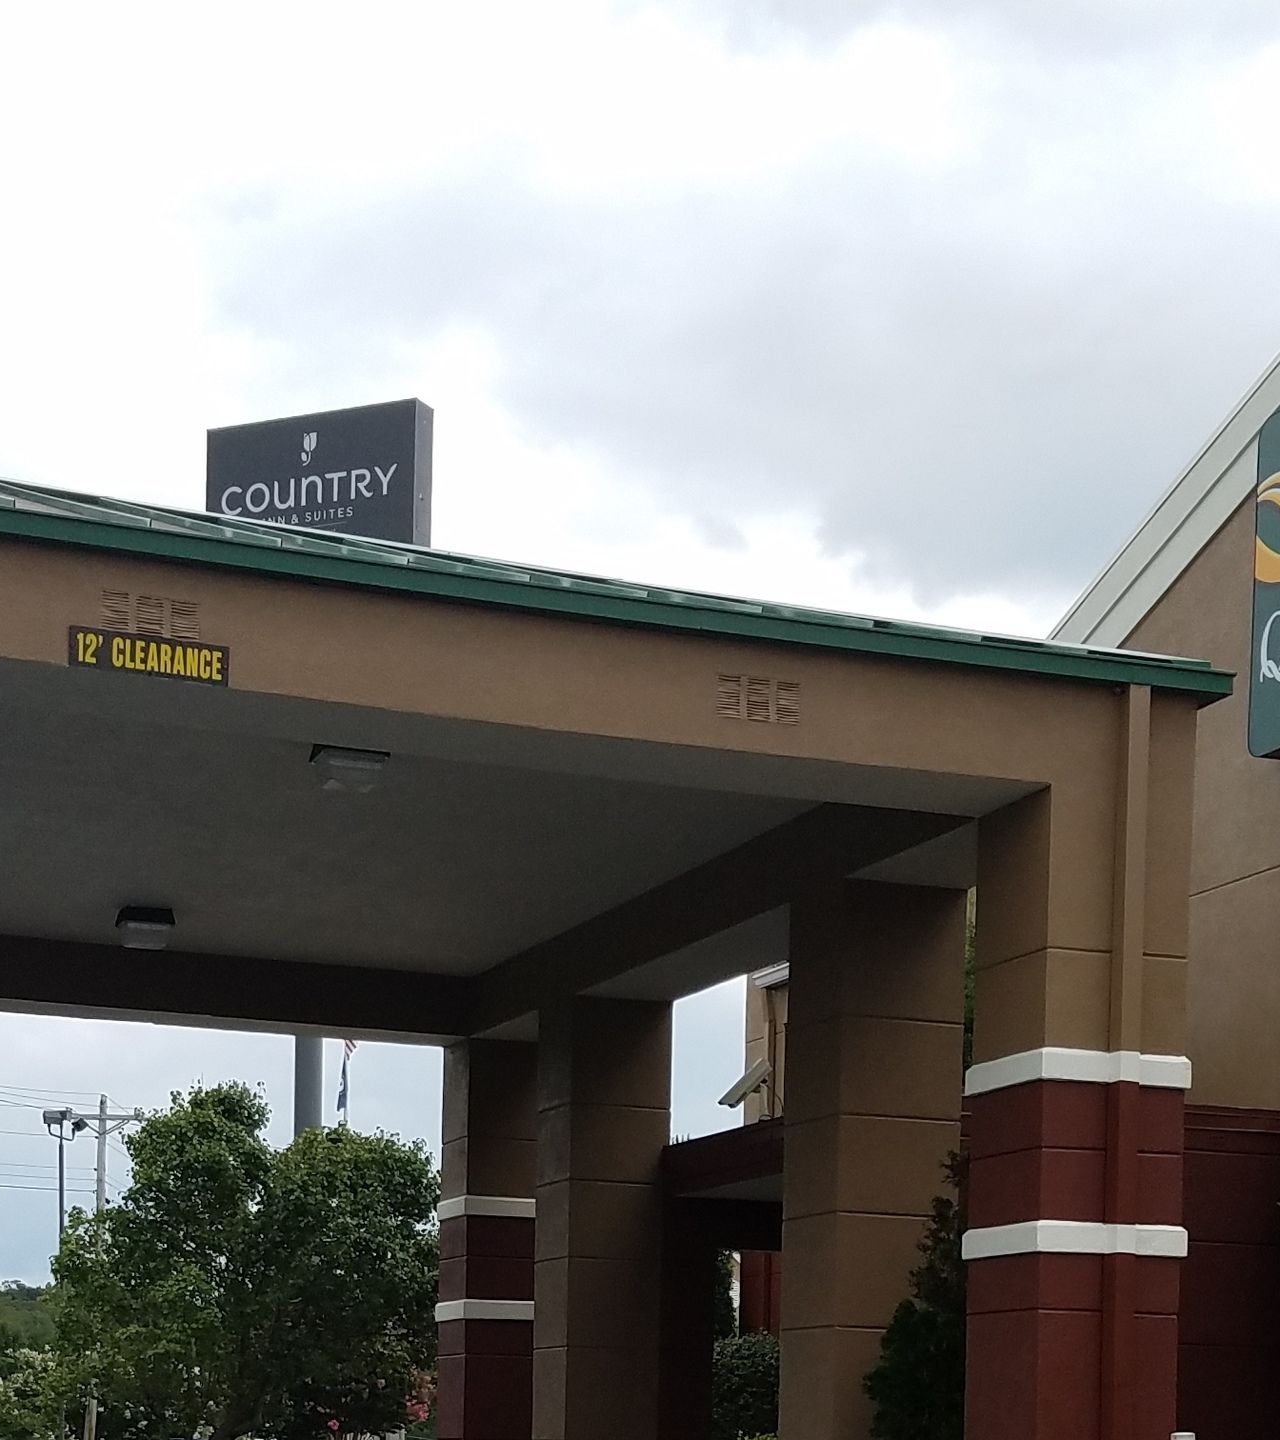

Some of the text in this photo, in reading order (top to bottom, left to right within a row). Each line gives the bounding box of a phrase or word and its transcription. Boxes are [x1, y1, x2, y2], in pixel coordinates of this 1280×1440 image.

[262, 506, 353, 525] NN & SUITES
[76, 631, 223, 681] 12' CLEARANCE
